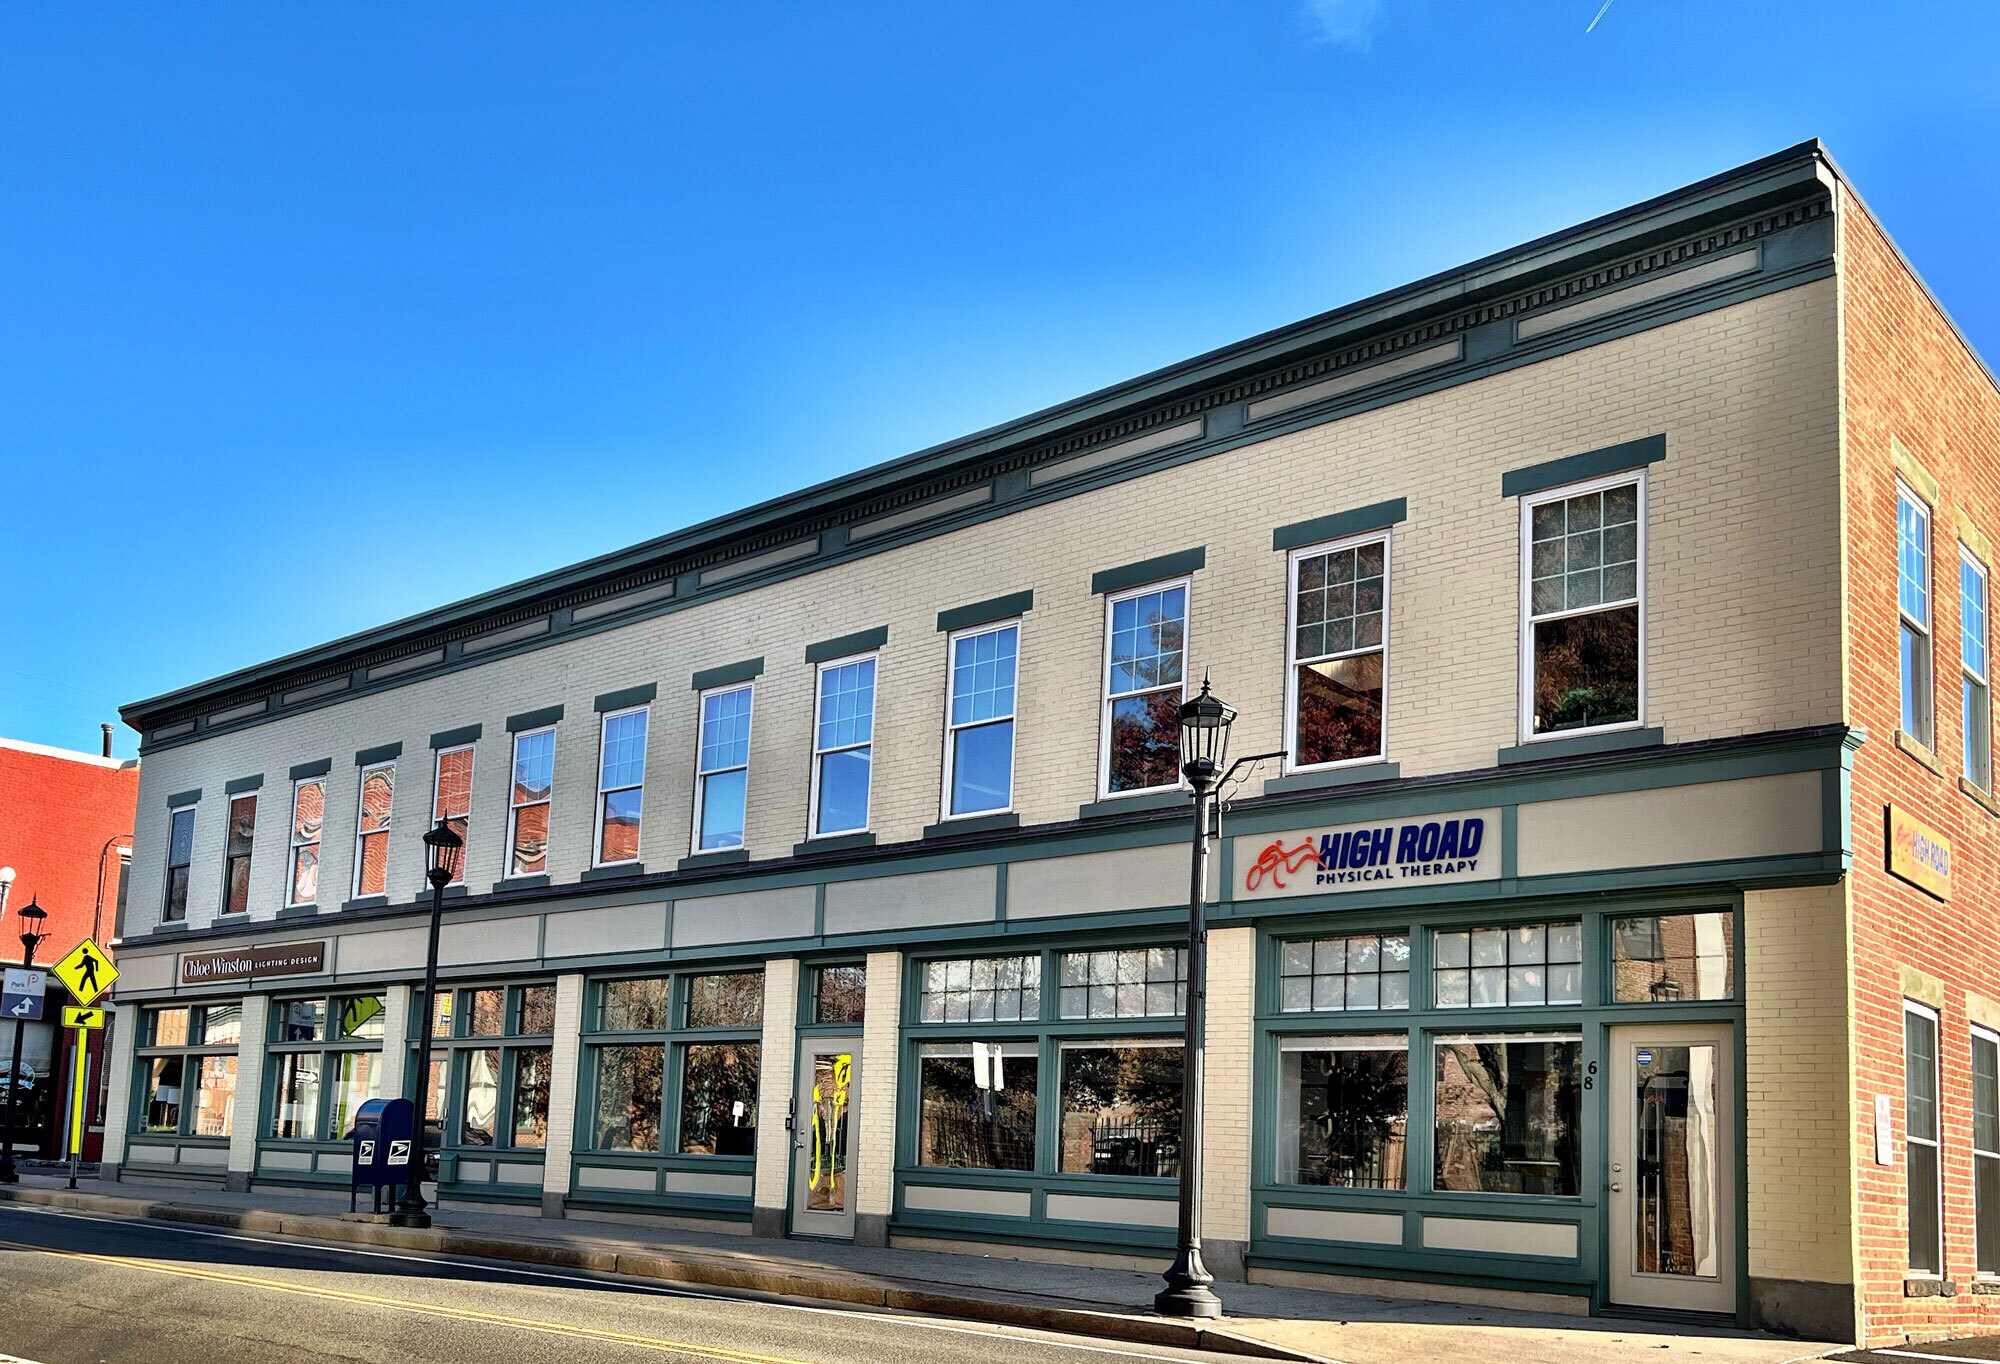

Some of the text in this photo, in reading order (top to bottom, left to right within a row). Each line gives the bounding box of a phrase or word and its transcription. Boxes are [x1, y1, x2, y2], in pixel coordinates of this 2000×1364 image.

[1317, 818, 1484, 872] HIGH ROAD
[1316, 859, 1479, 886] PHYSICAL THERAPY
[184, 956, 318, 978] Chloe Winston LIGHTING DESIGN
